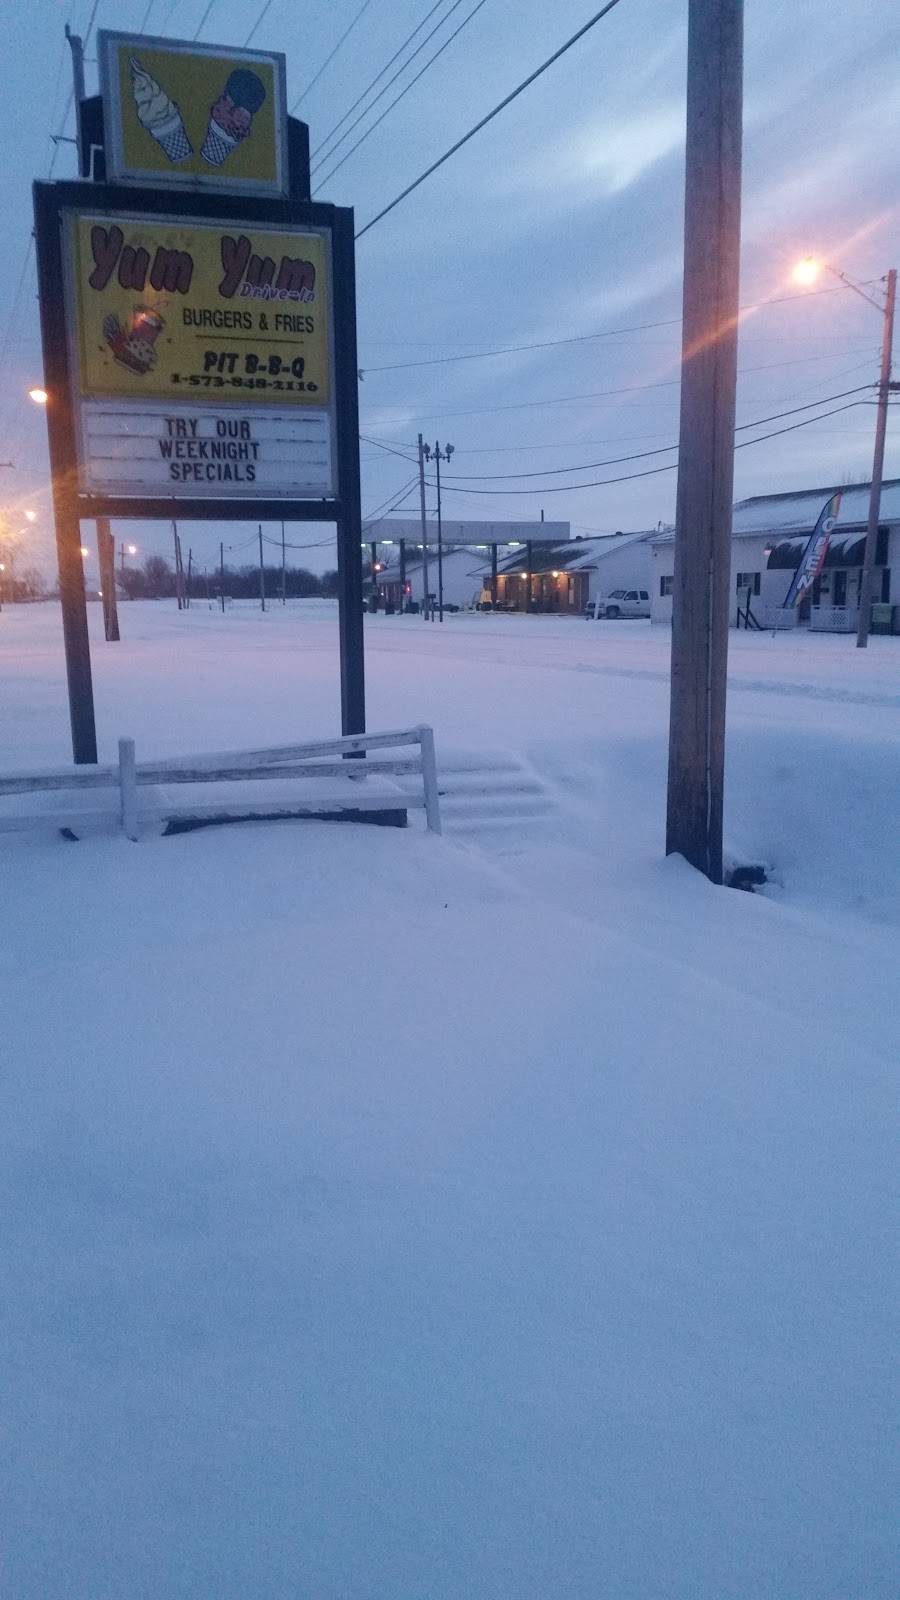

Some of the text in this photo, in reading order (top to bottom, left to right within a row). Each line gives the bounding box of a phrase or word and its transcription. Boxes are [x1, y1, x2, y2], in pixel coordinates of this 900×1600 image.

[89, 225, 316, 298] Yum Yum
[183, 308, 314, 334] BURGERS & FRIES
[204, 351, 305, 379] PIT B-B-Q
[171, 374, 318, 392] 1-573-848-2116
[165, 418, 250, 439] TRY OUR
[159, 440, 260, 461] WEEKNIGHT
[170, 463, 256, 482] SPECIALS
